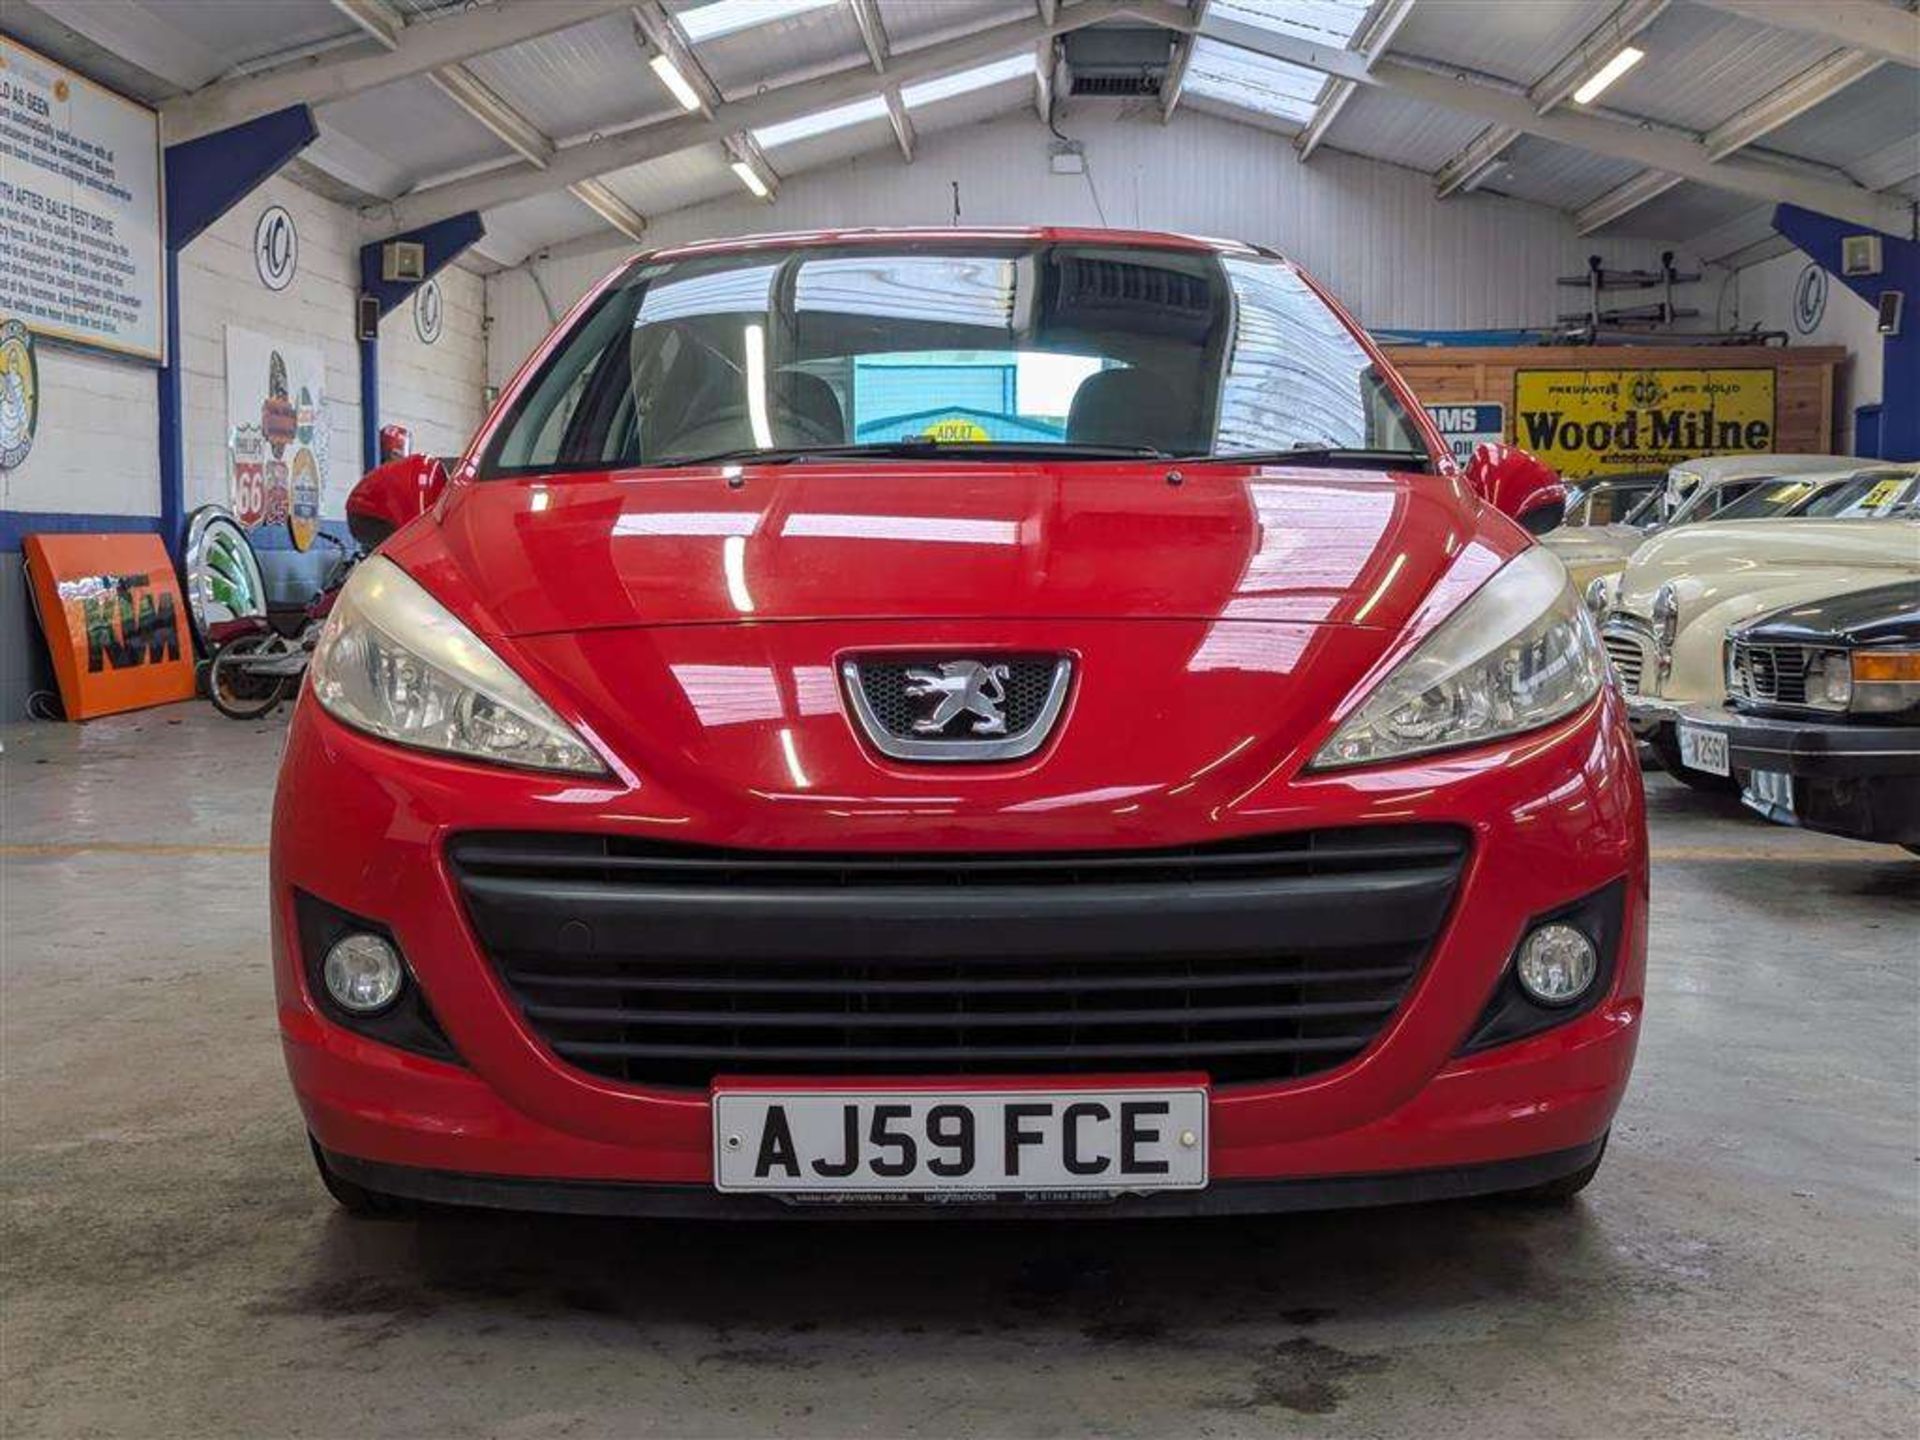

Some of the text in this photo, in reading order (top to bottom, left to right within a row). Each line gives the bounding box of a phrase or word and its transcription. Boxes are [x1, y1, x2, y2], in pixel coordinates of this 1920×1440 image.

[27, 91, 50, 117] SEEN
[16, 187, 43, 212] AFTER
[45, 198, 68, 221] SALE
[69, 206, 90, 229] TEST
[91, 214, 113, 236] DRIVE
[240, 472, 262, 514] 66
[85, 573, 181, 673] KTM
[754, 1101, 1170, 1178] AJ59 FCE
